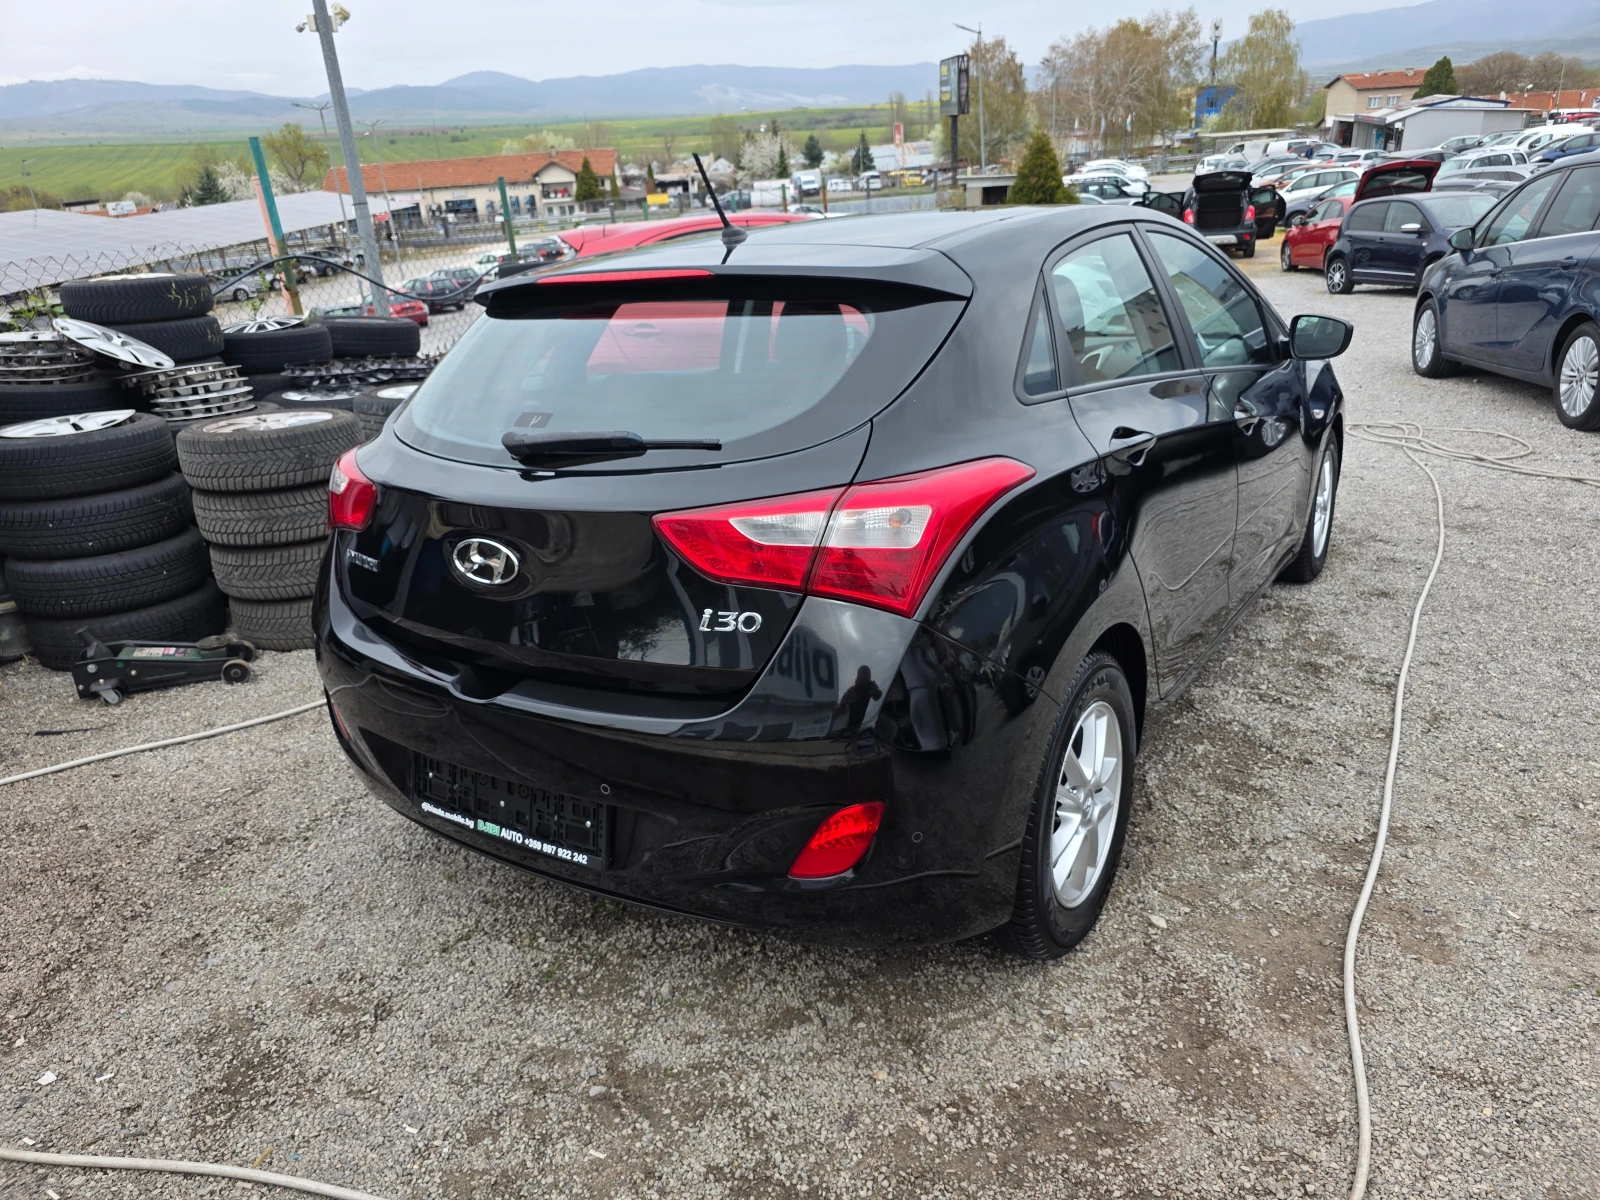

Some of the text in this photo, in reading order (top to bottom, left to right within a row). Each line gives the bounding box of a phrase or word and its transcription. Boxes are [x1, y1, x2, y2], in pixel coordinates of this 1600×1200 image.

[699, 608, 763, 634] i30
[477, 819, 501, 836] DJIBI
[500, 828, 523, 844] AUTO
[524, 838, 542, 851] +359
[542, 842, 557, 855] 897
[557, 847, 572, 860] 922
[572, 852, 588, 865] 242
